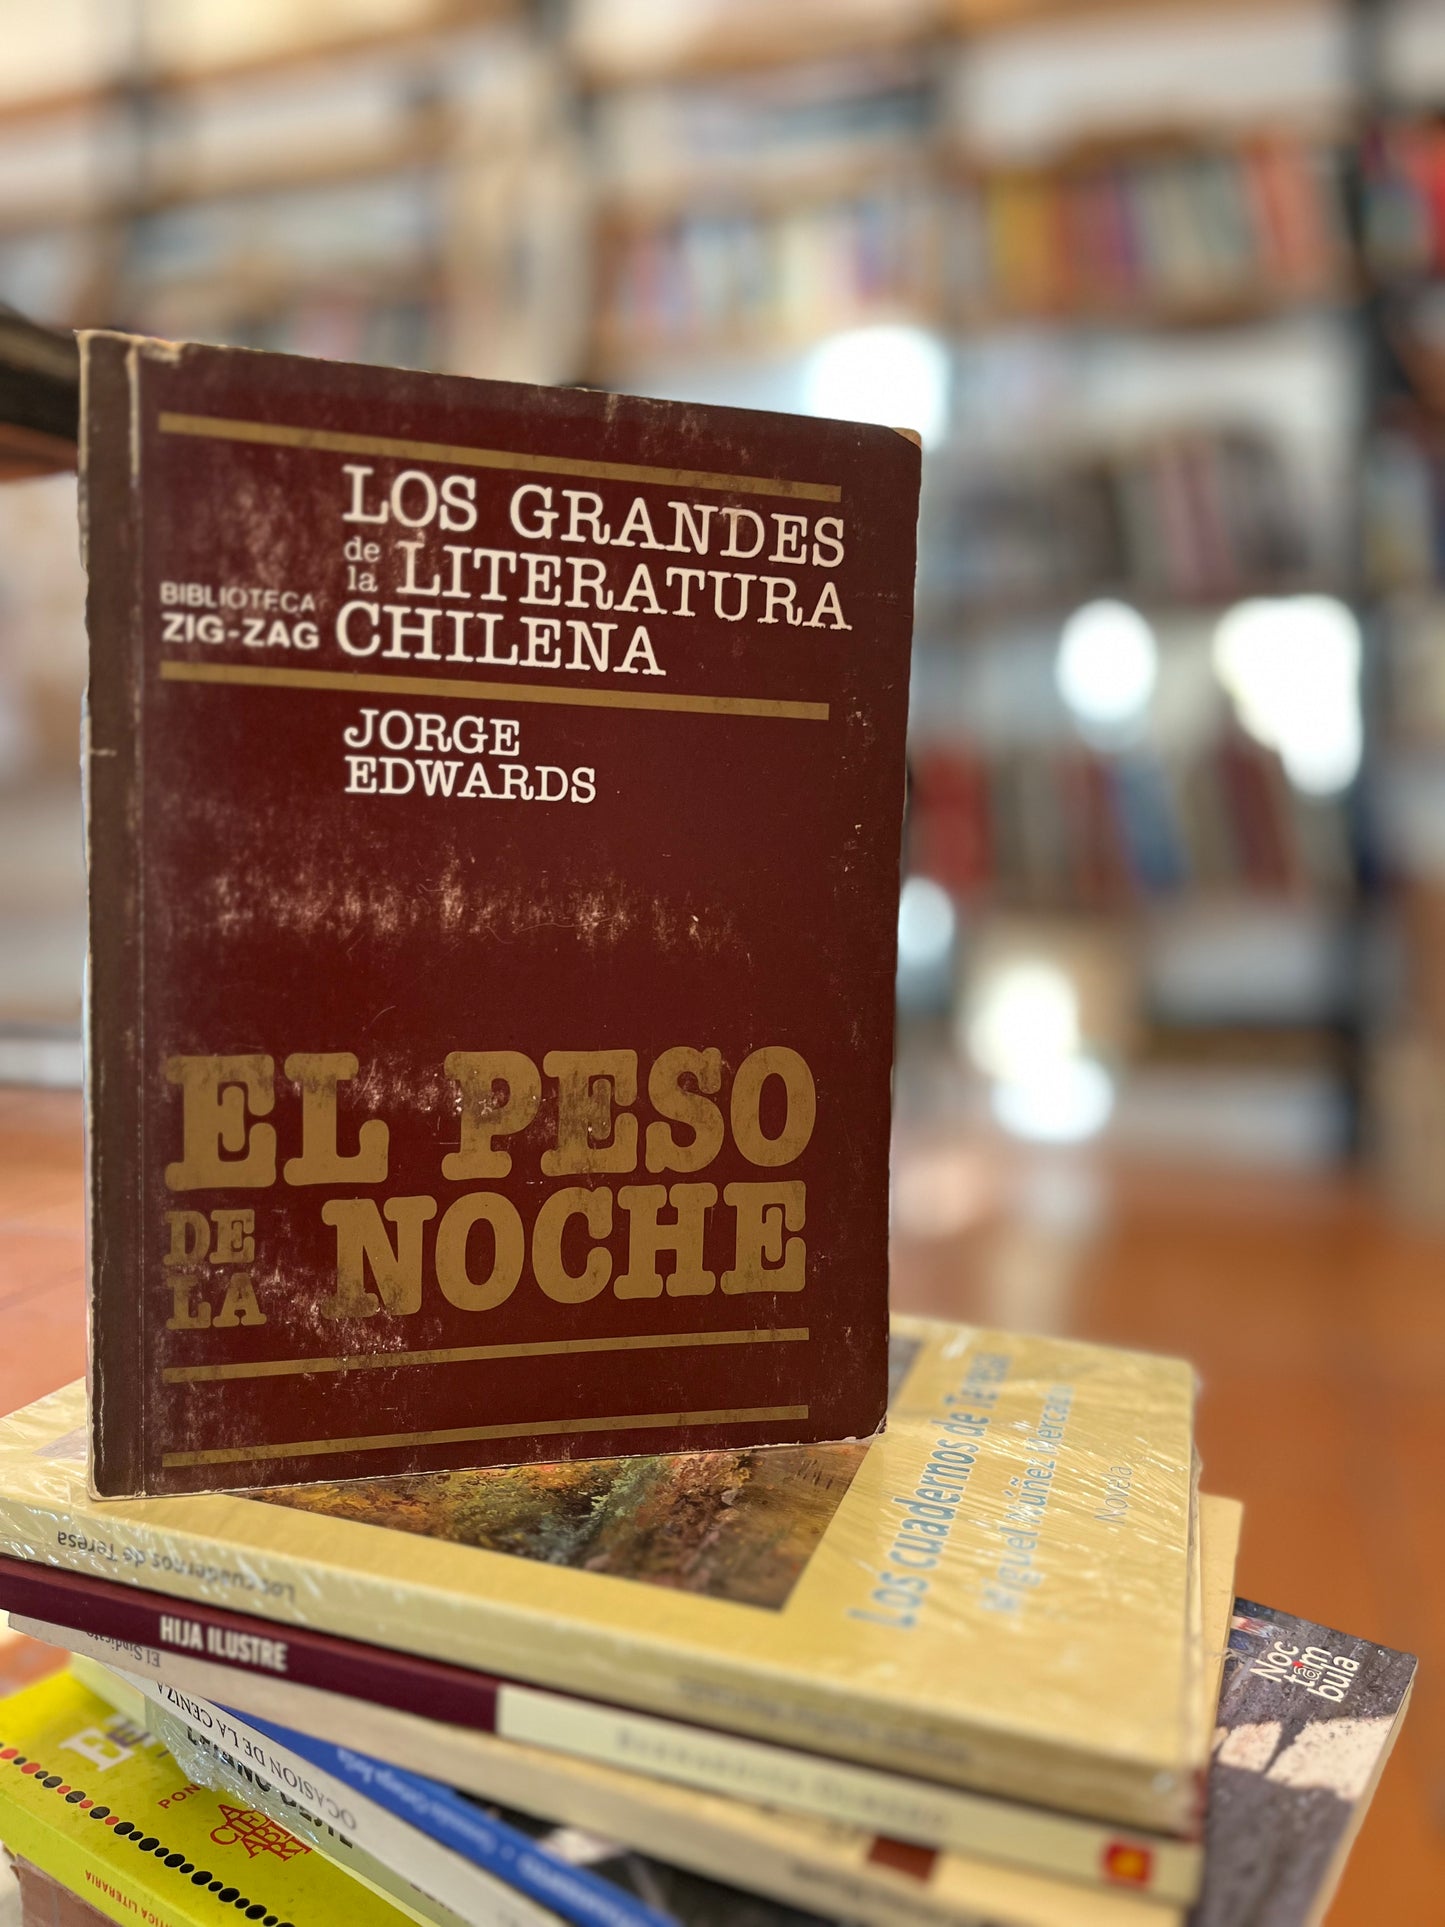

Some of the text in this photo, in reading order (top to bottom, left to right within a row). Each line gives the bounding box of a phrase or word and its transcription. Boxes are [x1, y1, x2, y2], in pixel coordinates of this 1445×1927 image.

[342, 465, 845, 568] LOS GRANDES
[344, 536, 380, 563] de
[160, 580, 316, 613] BIBLIOTECA
[348, 540, 853, 631] la LITERATURA
[161, 612, 319, 649] ZIG-ZAG
[336, 600, 667, 676] CHILENA
[343, 708, 520, 757] JORGE
[344, 755, 596, 804] EDWARDS
[165, 1046, 816, 1192] EL PESO
[164, 1209, 255, 1265] DE
[166, 1180, 807, 1330] LA NOCHE
[930, 1411, 989, 1437] de
[888, 1438, 979, 1569] cuadernos
[1094, 1464, 1133, 1525] Novela
[57, 1531, 118, 1562] Teresa
[847, 1571, 928, 1628] Los
[146, 1650, 161, 1669] El
[160, 1615, 288, 1672] HIJA ILUSTRE
[1250, 1640, 1299, 1683] Noc
[1307, 1655, 1360, 1703] bula
[156, 1682, 357, 1830] OCASION DE LA CENIZA
[85, 1869, 138, 1914] LITERARIA
